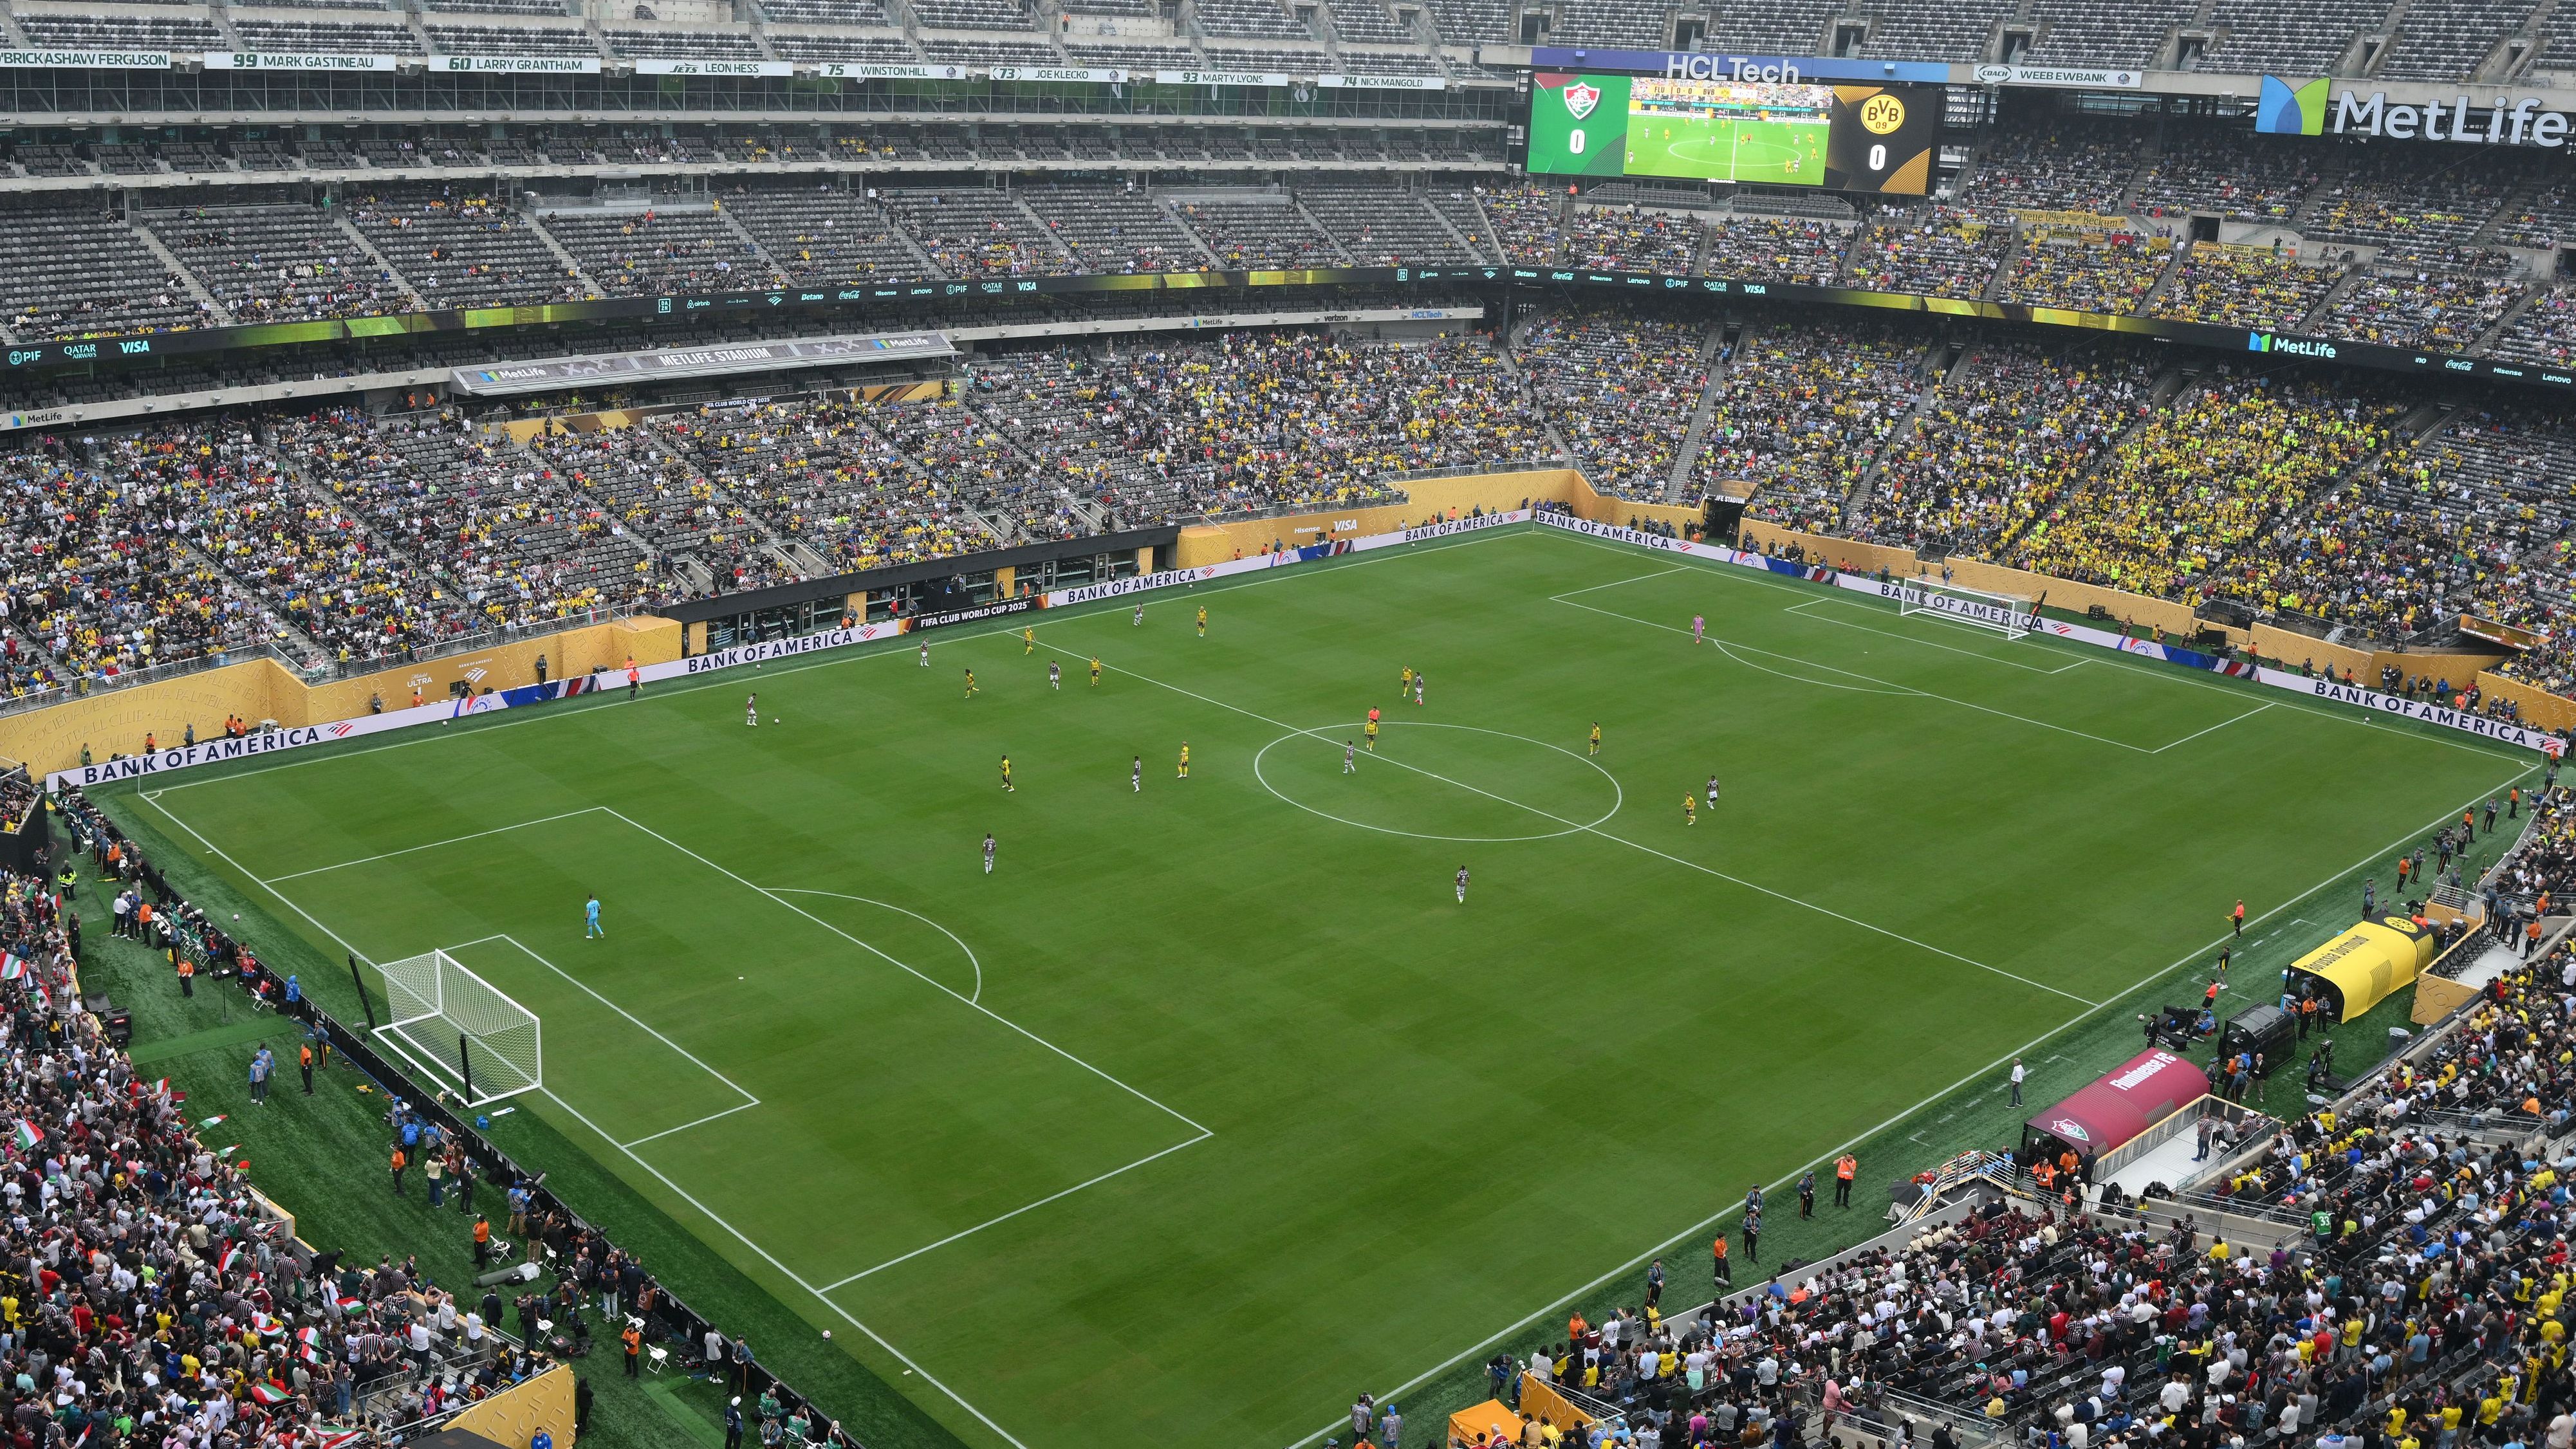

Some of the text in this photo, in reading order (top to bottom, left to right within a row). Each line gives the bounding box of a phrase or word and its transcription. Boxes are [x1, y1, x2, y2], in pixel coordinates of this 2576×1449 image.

[0, 52, 167, 65] 'BRICKASHAW FERGUSON
[234, 54, 373, 68] 99 MARK GASTINEAU
[449, 57, 582, 71] 60 LARRY GRANTHAM
[669, 62, 759, 73] JETS LEON HESS
[828, 64, 928, 77] 75 WINSTON HILL
[1000, 68, 1088, 79] 73 JOE KLECKO
[1667, 55, 1799, 84] HCLTech
[1182, 72, 1263, 83] 93 MARTY LYONS
[1342, 77, 1423, 88] 74 NICK MANGOLD
[1982, 69, 2107, 83] COACH WEEB EWBANK
[1867, 100, 1899, 122] BVB
[2333, 90, 2568, 147] MetLife
[1570, 129, 1585, 154] 0
[1869, 144, 1886, 171] 0
[2018, 210, 2118, 227] Treue 09er Beckum
[955, 285, 967, 293] PIF
[1017, 282, 1037, 291] VISA
[1675, 280, 1689, 288] PIF
[1703, 281, 1727, 289] QATAR
[1743, 284, 1766, 295] VISA
[118, 340, 150, 354] VISA
[889, 338, 929, 348] MetLife
[2274, 337, 2337, 358] MetLife
[23, 351, 41, 362] PIF
[64, 344, 96, 356] QATAR
[658, 347, 772, 367] METLIFE STADIUM
[498, 368, 547, 380] MetLife
[2493, 367, 2523, 376] Hisense
[2542, 373, 2571, 384] Lenovo
[27, 412, 62, 424] MetLife
[1724, 496, 1745, 504] STADIUM
[1294, 526, 1320, 534] Hisense
[1333, 519, 1358, 531] VISA
[1405, 514, 1503, 541] BANK OF AMERICA
[1537, 511, 1670, 549] BANK OF AMERICA
[1068, 570, 1196, 604] BANK OF AMERICA
[1881, 584, 2044, 631] BANK OF AMERICA
[920, 604, 1007, 628] FIFA CLUB WORLD CUP
[689, 630, 853, 673] BANK OF AMERICA
[407, 676, 433, 688] ULTRA
[2315, 682, 2527, 746] BANK OF AMERICA
[85, 756, 157, 784] BANK
[165, 746, 197, 768] OF
[205, 726, 320, 762] AMERICA
[2303, 934, 2370, 972] Borussia Dortmund
[2109, 1052, 2177, 1091] Fluminense FC
[2319, 1215, 2330, 1226] 33
